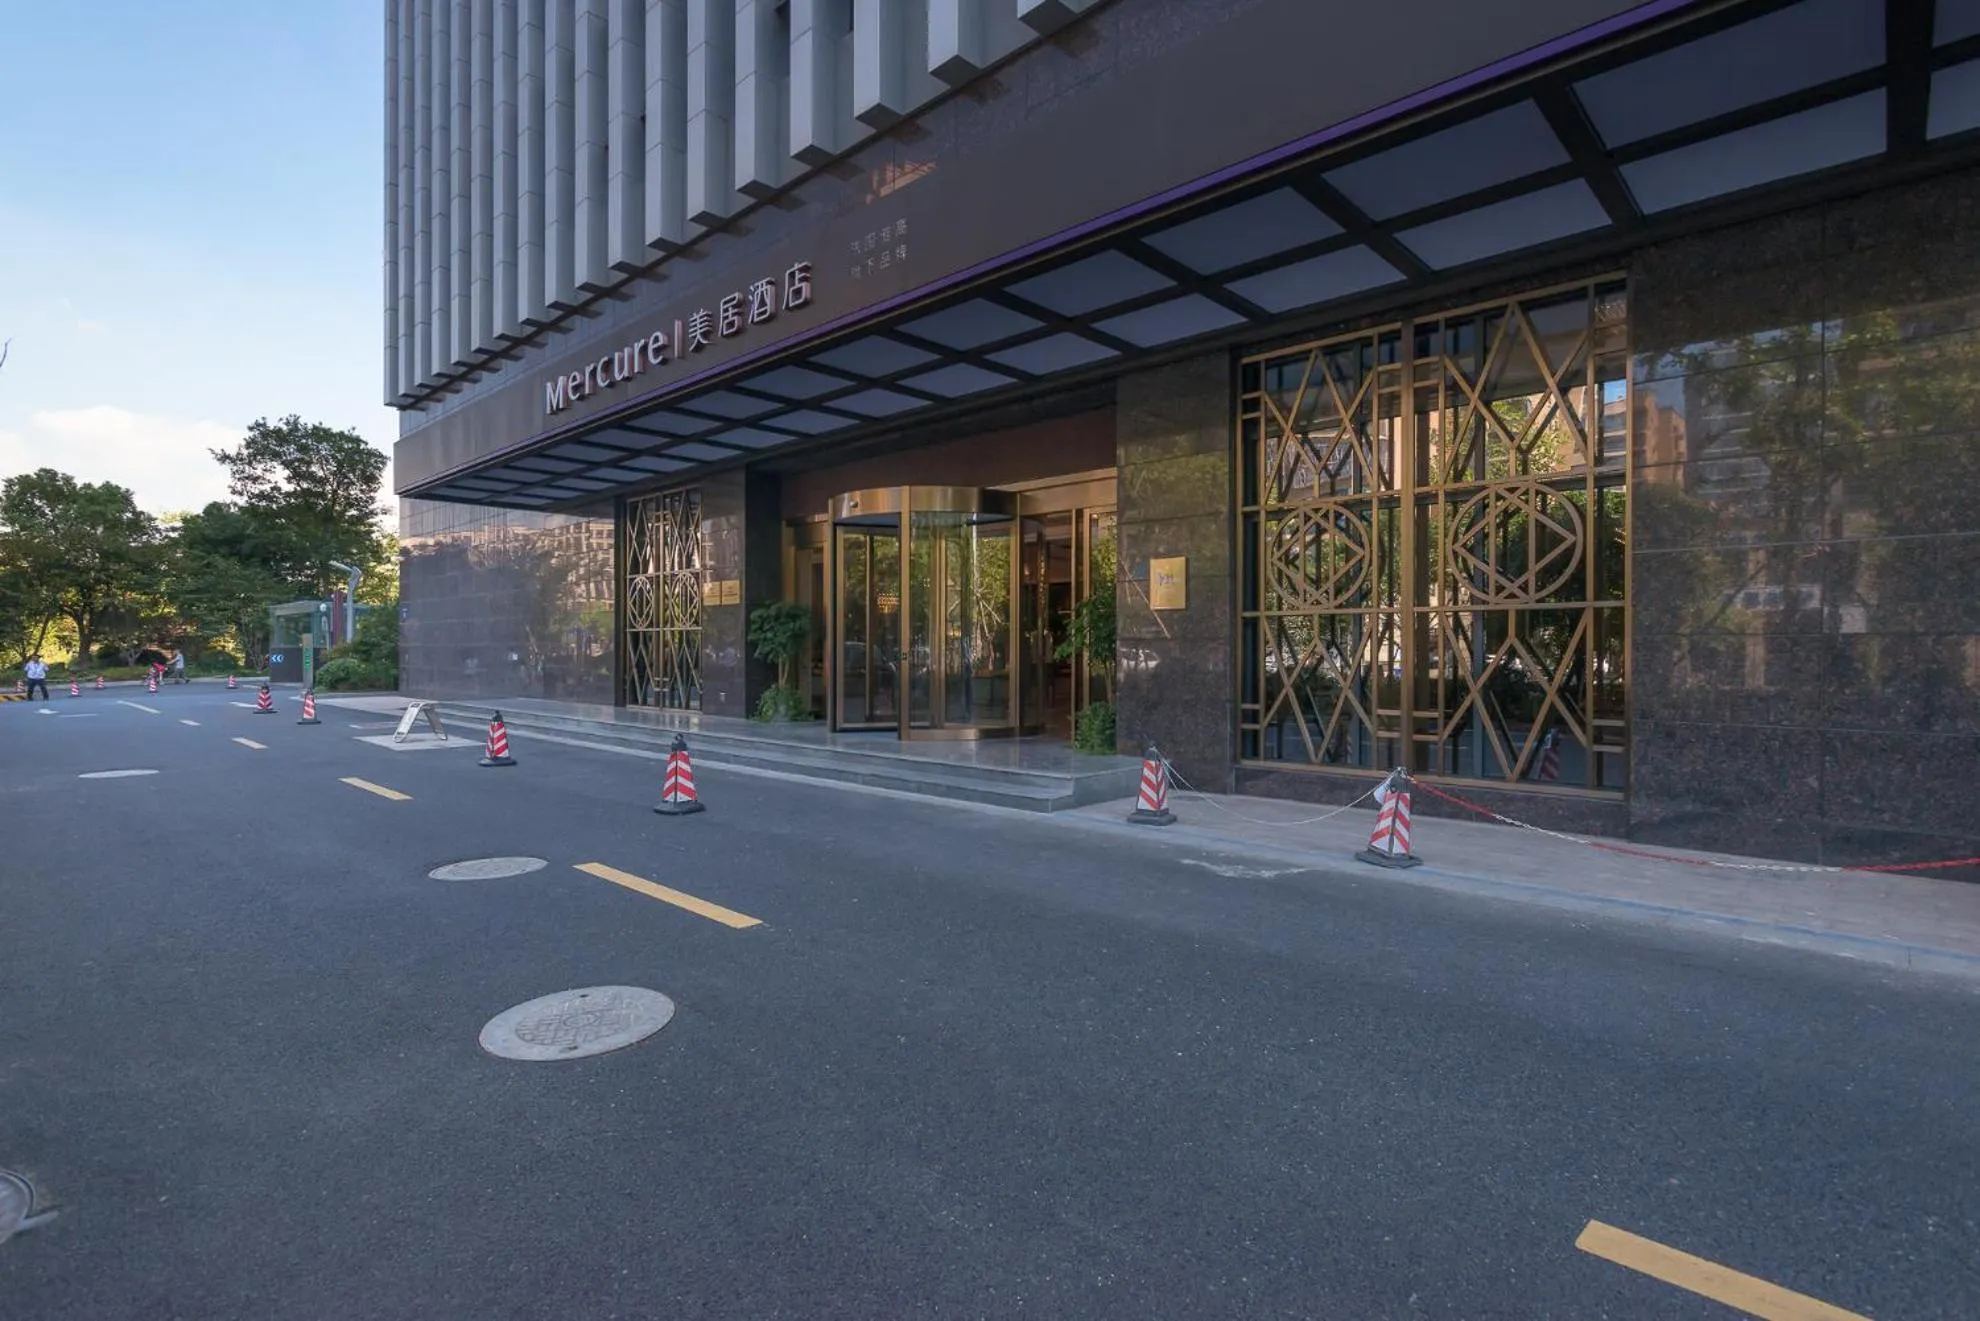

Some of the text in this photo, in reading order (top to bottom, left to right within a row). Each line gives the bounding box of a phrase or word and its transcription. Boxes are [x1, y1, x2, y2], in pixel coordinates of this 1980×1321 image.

[688, 260, 812, 352] 美居酒店
[545, 330, 668, 414] Mercure
